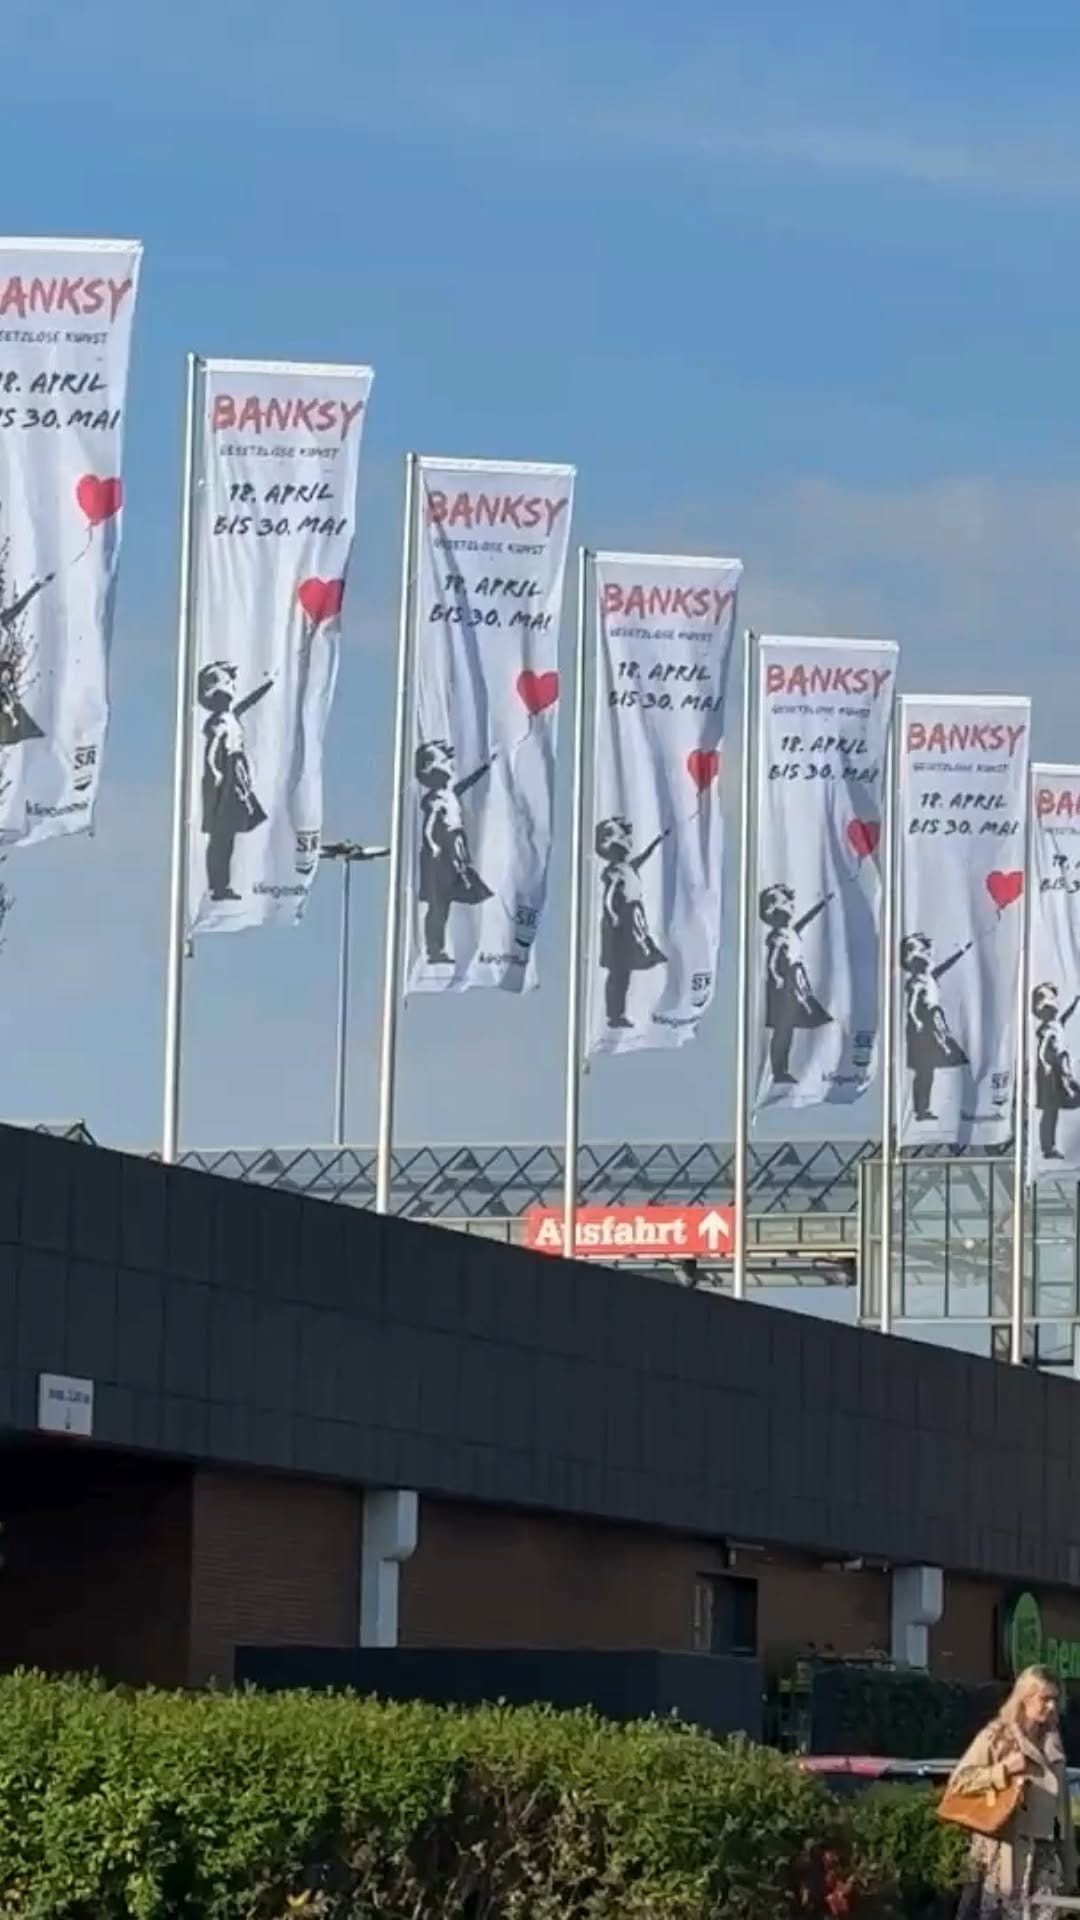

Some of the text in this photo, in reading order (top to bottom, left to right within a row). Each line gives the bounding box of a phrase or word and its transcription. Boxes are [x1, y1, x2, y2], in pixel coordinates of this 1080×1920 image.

[65, 332, 109, 344] KUNST
[30, 371, 107, 394] APRIL
[22, 408, 61, 428] 30.
[67, 409, 120, 430] MAI
[213, 394, 363, 441] BANKSY
[230, 482, 334, 505] 18. APRIL
[426, 490, 569, 537] BANKSY
[213, 515, 347, 537] BIS 30. MAI
[474, 576, 541, 597] APRIL
[603, 583, 736, 626] BANKSY
[429, 603, 553, 631] BIS 30. MAI
[619, 661, 711, 681] 18. APRIL
[766, 664, 891, 700] BANKSY
[608, 690, 723, 712] BIS 30. MAI
[782, 736, 868, 754] 18. APRIL
[907, 723, 1025, 757] BANKSY
[768, 763, 879, 783] BIS 30. MAI
[921, 792, 1008, 809] 18. APRIL
[909, 818, 1018, 835] BIS 30. MAI
